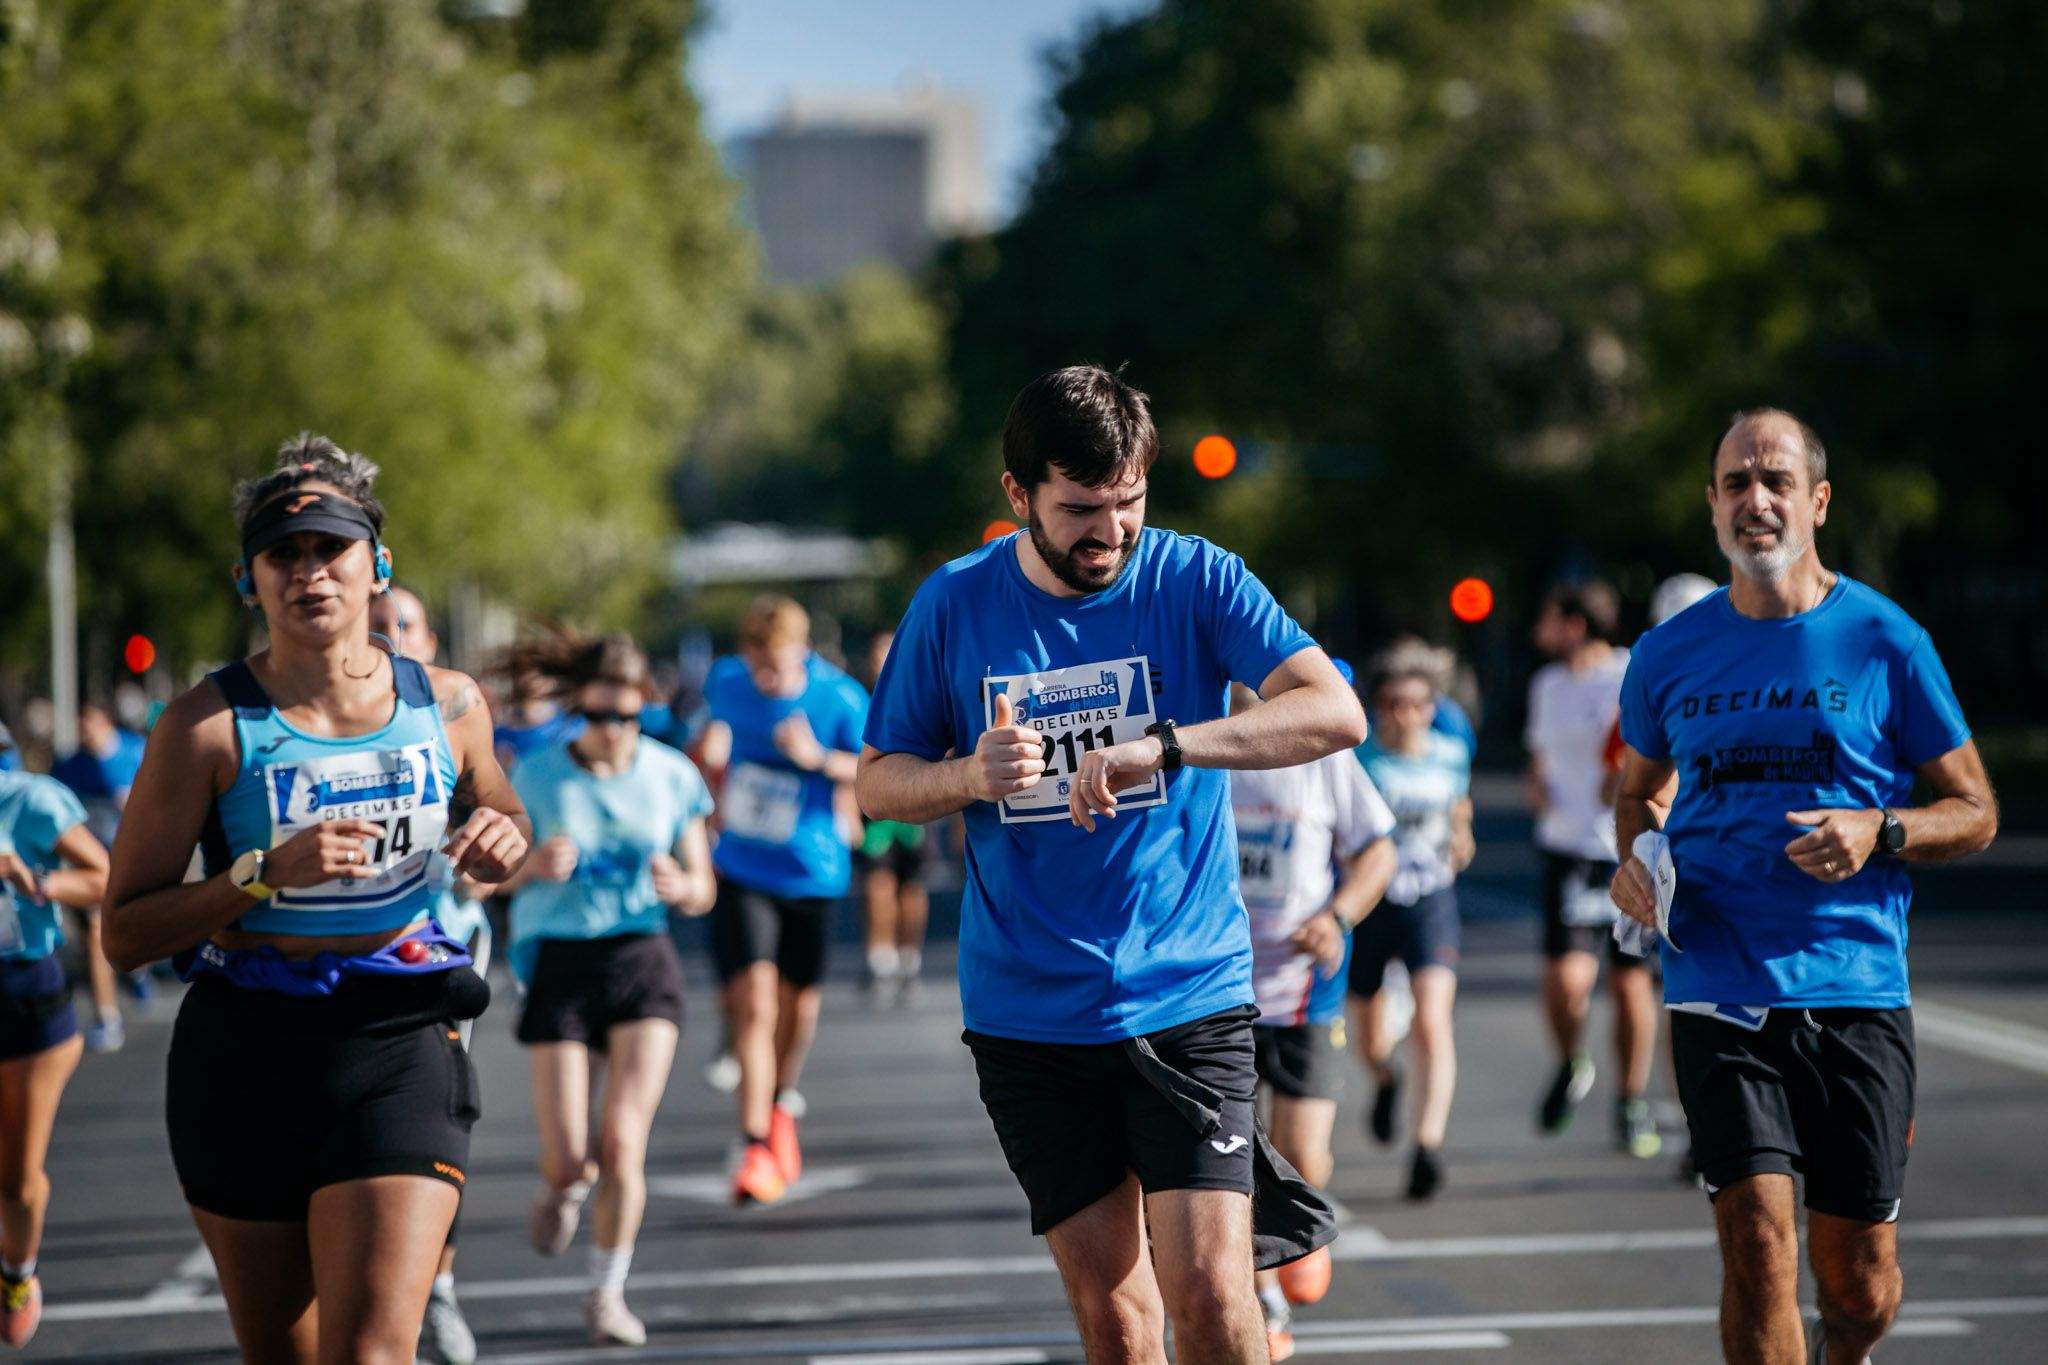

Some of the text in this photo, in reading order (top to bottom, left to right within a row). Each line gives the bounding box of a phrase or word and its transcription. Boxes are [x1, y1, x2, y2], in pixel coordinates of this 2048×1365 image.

[1040, 683, 1116, 705] BOMBEROS
[1683, 688, 1849, 719] DECIMAS
[1034, 708, 1118, 731] DECIMAS
[324, 797, 413, 822] DECIMAS
